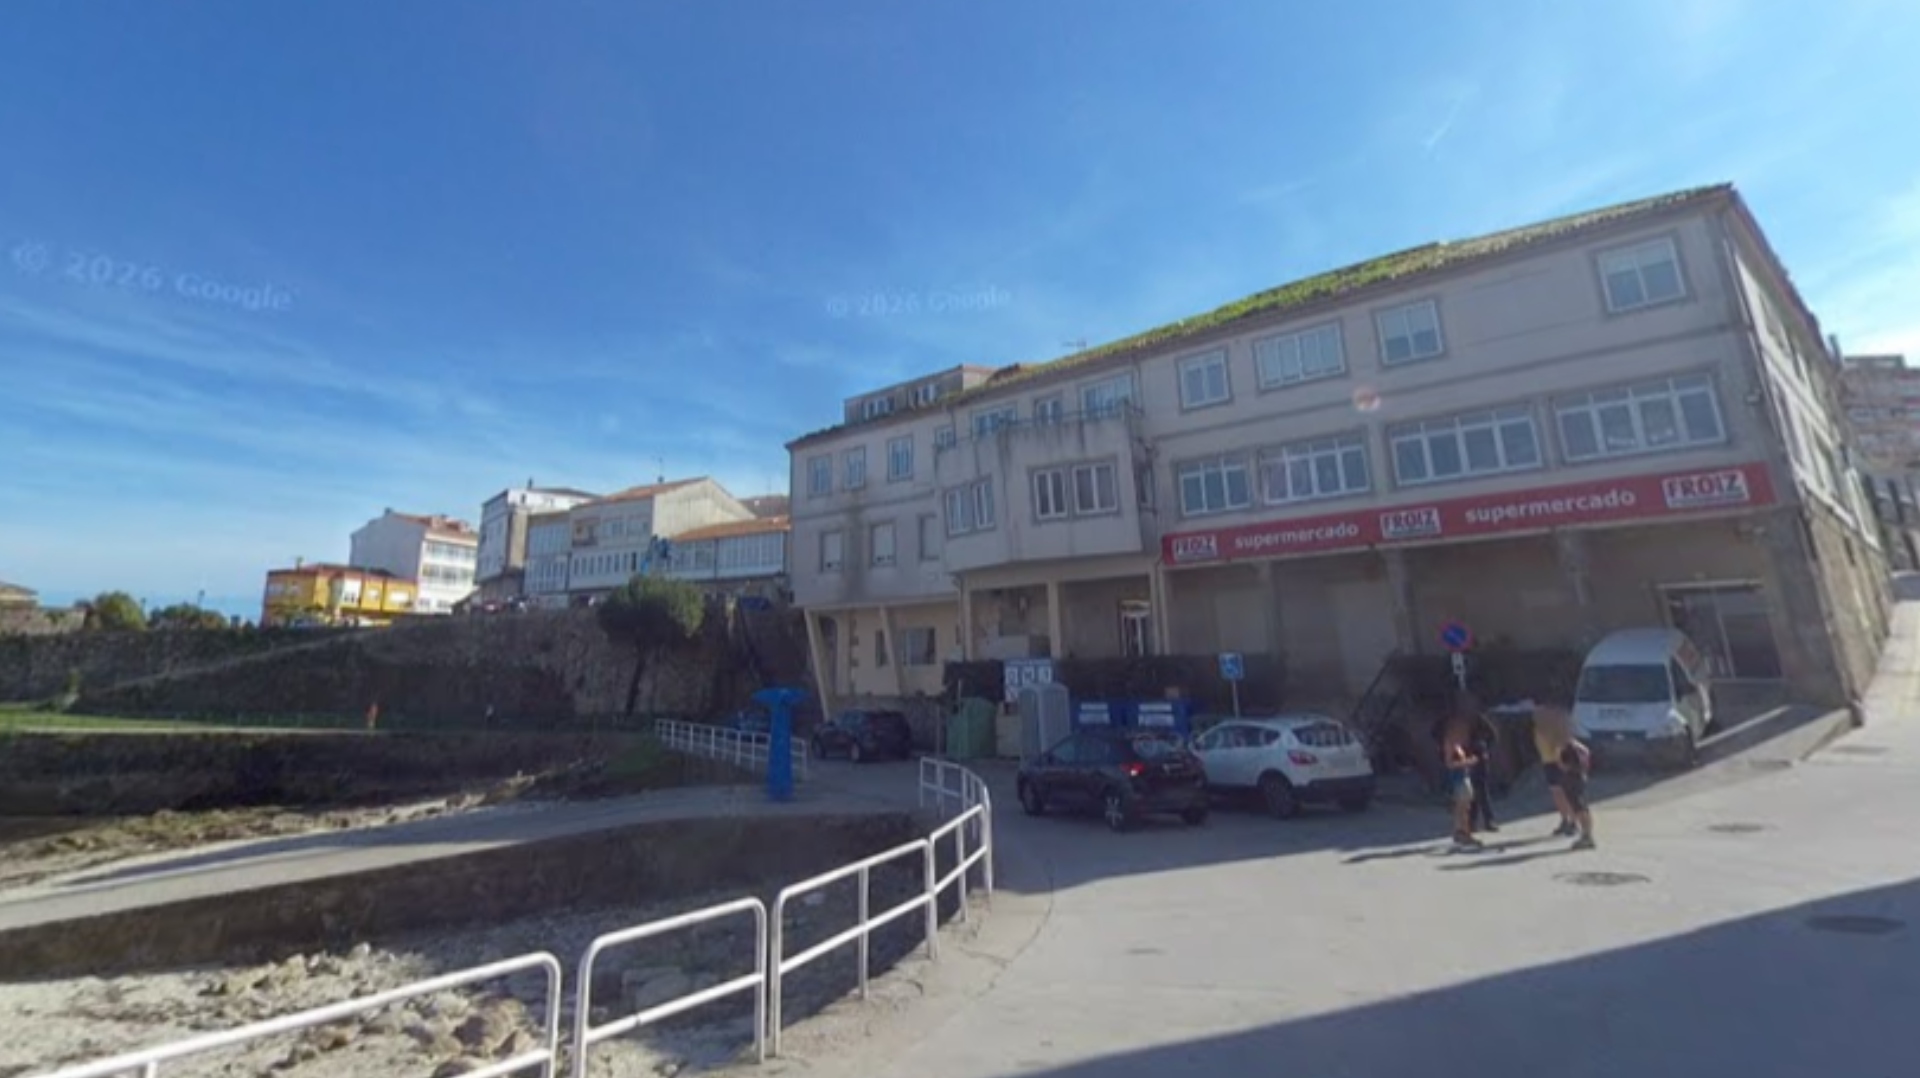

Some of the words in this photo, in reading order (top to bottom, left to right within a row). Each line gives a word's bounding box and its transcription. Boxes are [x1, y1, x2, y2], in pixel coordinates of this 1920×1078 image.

[1174, 537, 1216, 556] FROIZ
[1235, 523, 1357, 549] supermercado
[1386, 511, 1437, 533] FROIZ
[1465, 489, 1635, 523] supermercado
[1667, 473, 1740, 499] FROIZ
